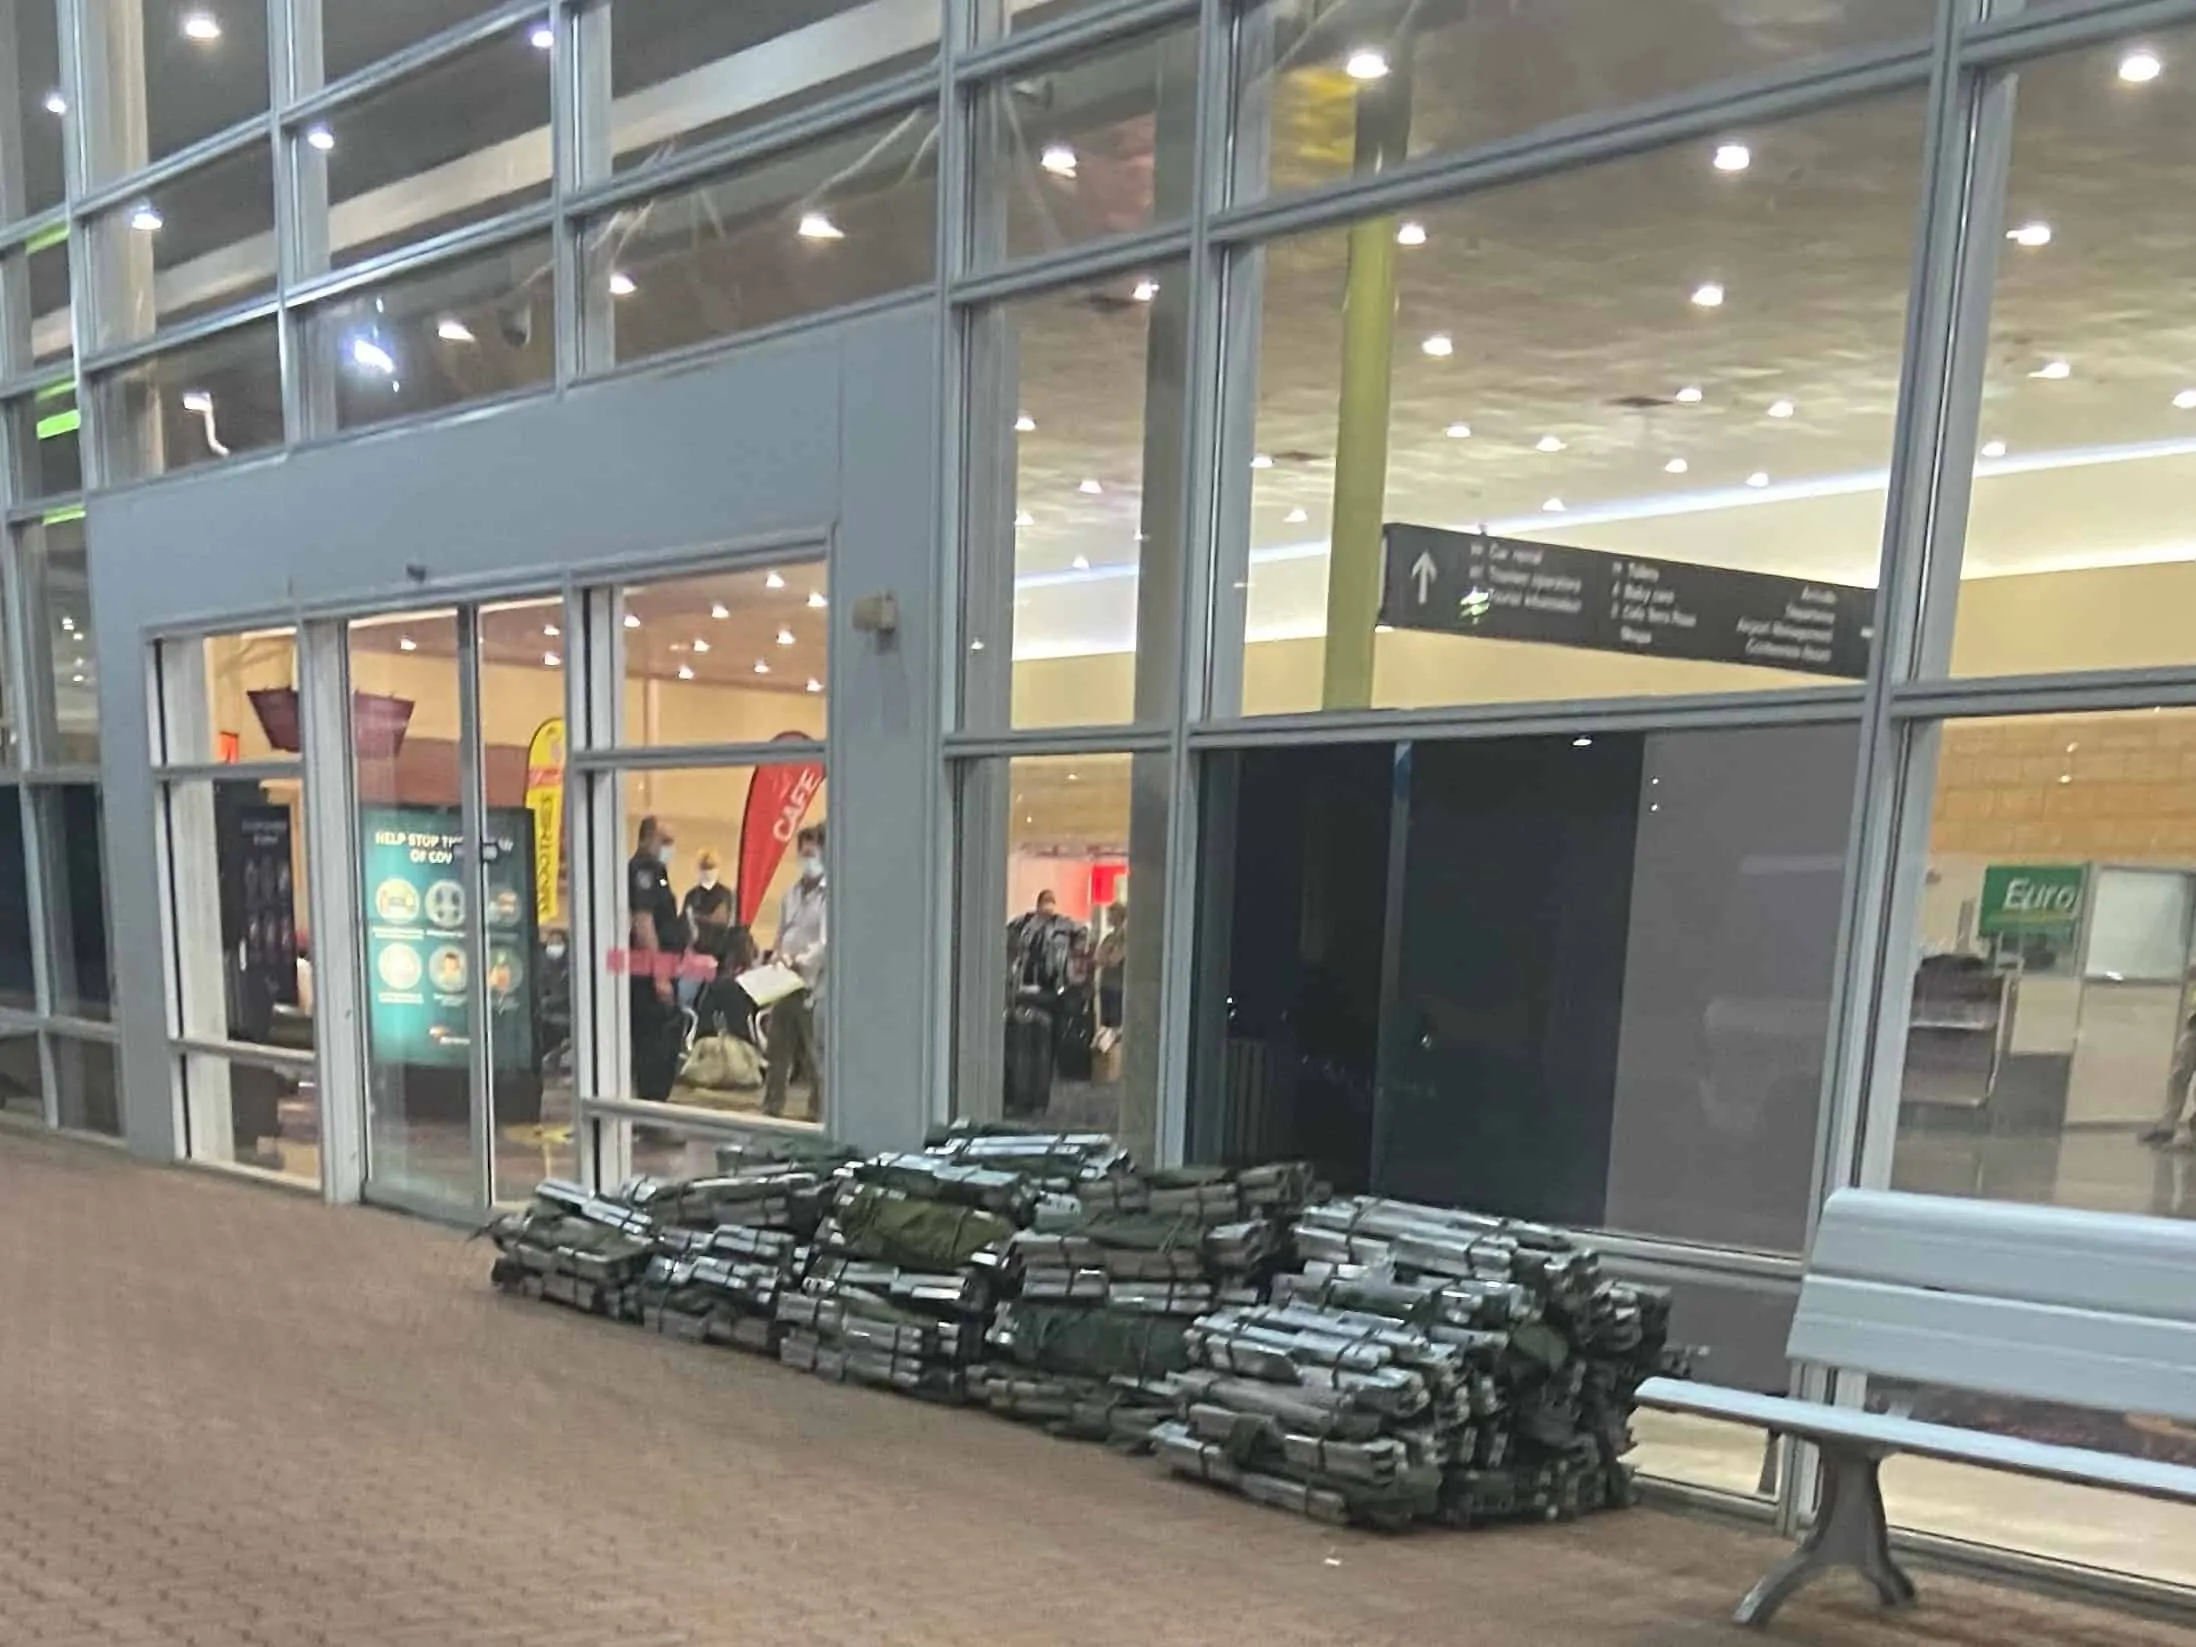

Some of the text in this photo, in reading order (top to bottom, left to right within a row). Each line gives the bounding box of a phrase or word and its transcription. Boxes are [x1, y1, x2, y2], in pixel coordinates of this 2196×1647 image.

[773, 766, 822, 841] CAFE
[375, 832, 406, 846] HELP
[407, 833, 439, 848] STOP
[2003, 877, 2080, 911] Euro
